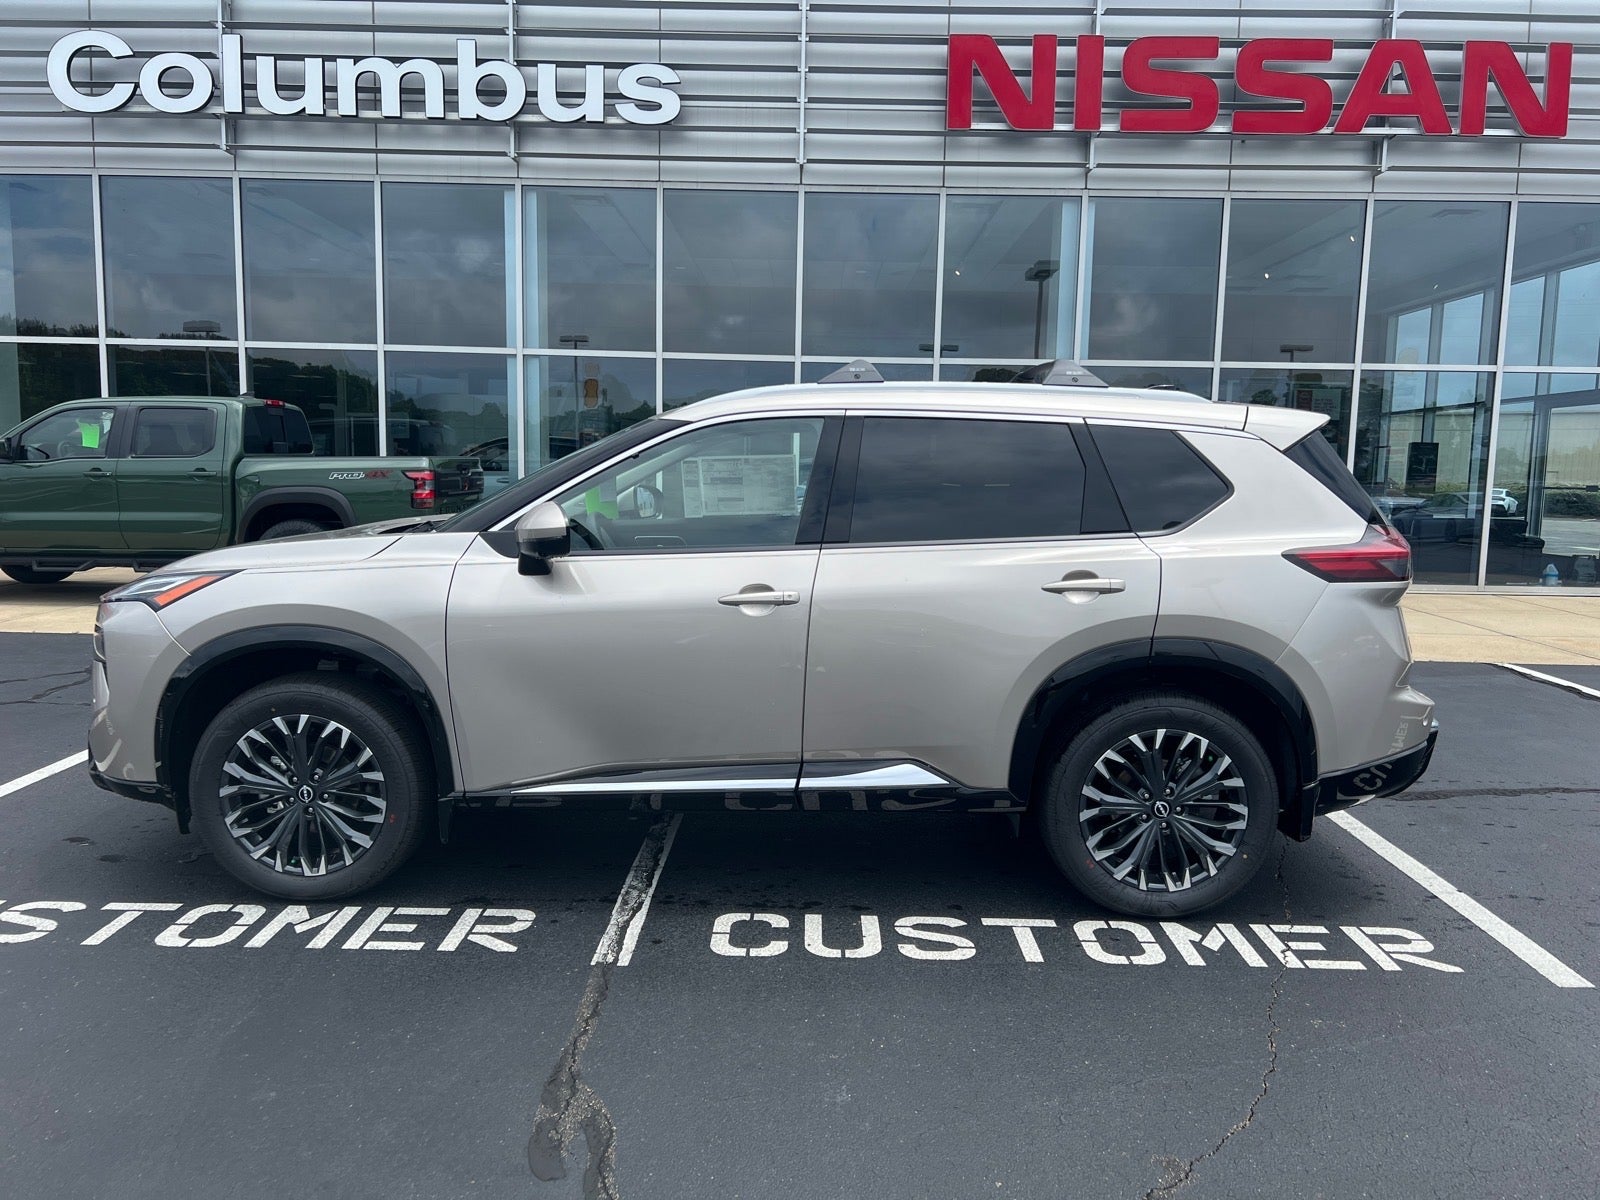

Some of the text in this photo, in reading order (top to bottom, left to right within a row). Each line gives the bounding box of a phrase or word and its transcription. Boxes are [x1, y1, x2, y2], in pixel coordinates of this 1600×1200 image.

[46, 29, 682, 127] Columbus
[946, 34, 1573, 138] NISSAN
[0, 899, 536, 953] STOMER
[710, 911, 1464, 973] CUSTOMER
